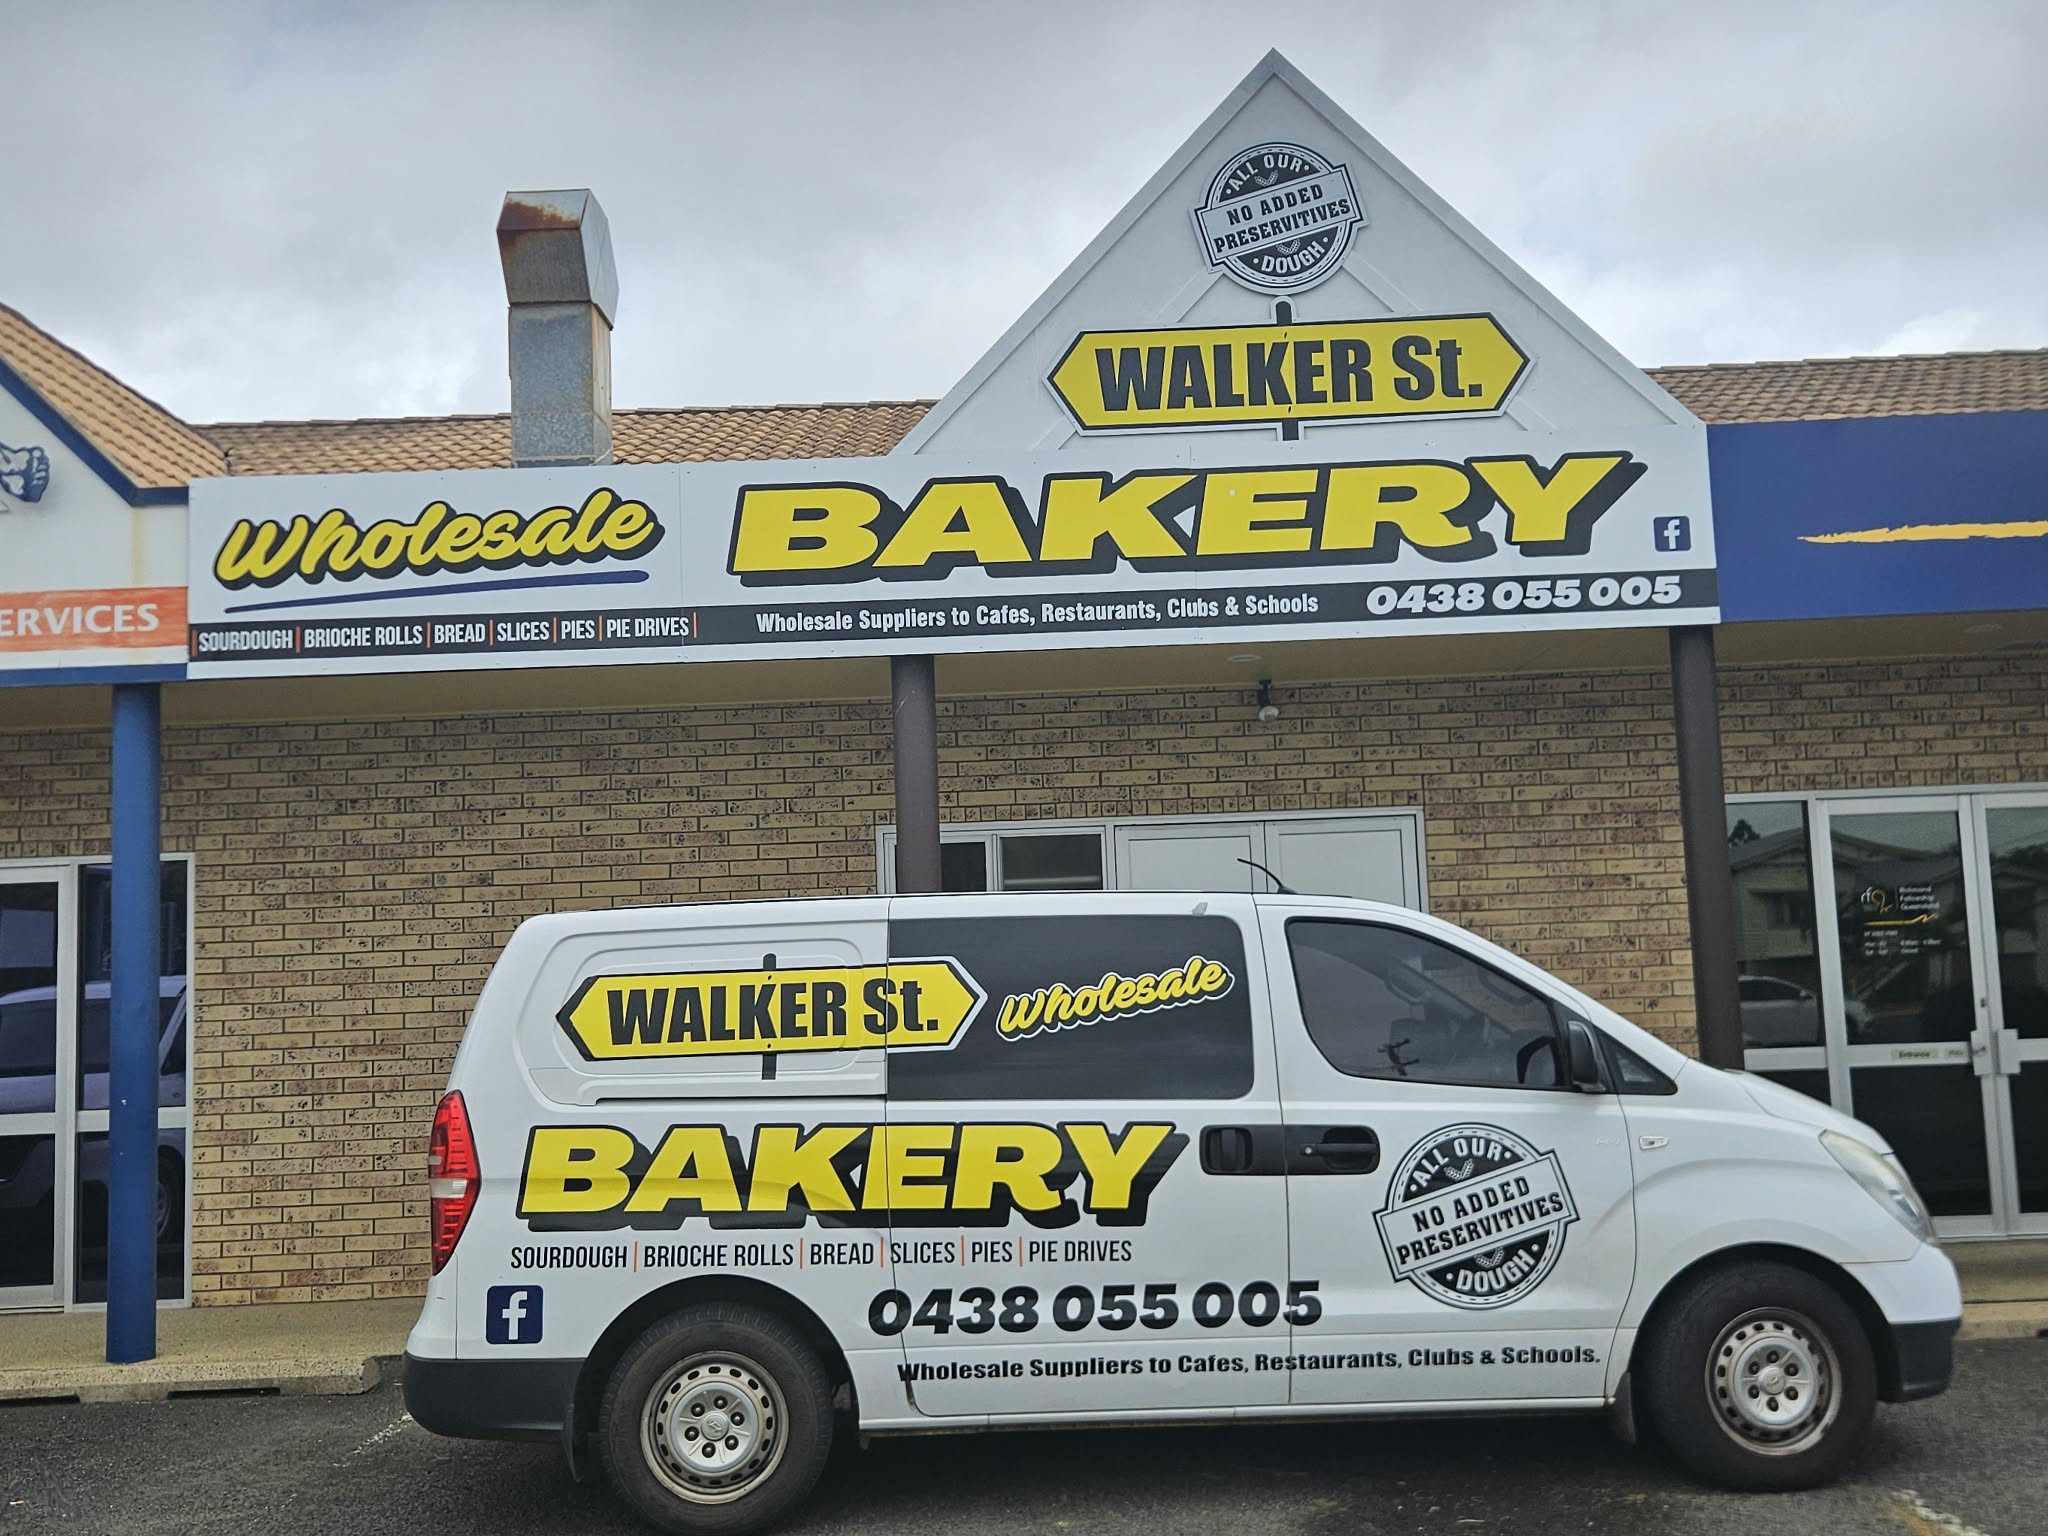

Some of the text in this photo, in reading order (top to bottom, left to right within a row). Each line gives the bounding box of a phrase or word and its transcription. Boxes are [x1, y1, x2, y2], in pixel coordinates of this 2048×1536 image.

[1228, 154, 1303, 191] ALL OUR
[1227, 183, 1324, 226] NO ADDED
[1213, 198, 1351, 253] PRESERVITIVES
[1261, 240, 1326, 274] DOUGH
[1094, 333, 1483, 412] WALKER St.
[728, 452, 1648, 585] BAKERY
[214, 486, 665, 590] Wholesale
[756, 593, 1319, 633] Wholesale Suppliers to Cafes, Restaurants, Clubs & Schools
[1365, 575, 1682, 616] 0438 055 005
[198, 630, 294, 652] SOURDOUGH
[303, 625, 424, 649] BRIOCHE ROLLS
[433, 623, 486, 644] BREAD
[497, 621, 550, 642] SLICES
[560, 619, 596, 640] PIES
[606, 617, 690, 638] PIE DRIVES
[606, 978, 940, 1045] WALKER St.
[995, 954, 1236, 1041] Wholesale
[518, 1122, 1190, 1231] BAKERY
[1412, 1137, 1502, 1187] ALL OUR
[1412, 1175, 1530, 1233] NO ADDED
[1395, 1191, 1564, 1265] PRESERVITIVES
[510, 1246, 628, 1269] SOURDOUGH
[643, 1243, 794, 1268] BRIOCHE ROLLS
[809, 1242, 875, 1265] BREAD
[890, 1241, 956, 1264] SLICES
[970, 1240, 1014, 1263] PIES
[1028, 1239, 1133, 1263] PIE DRIVES
[1456, 1248, 1536, 1292] DOUGH
[867, 1280, 1323, 1337] 0438 055 005
[897, 1345, 1601, 1382] Wholesale Suppliers to Cafes, Restaurants, Clubs & Schools.
